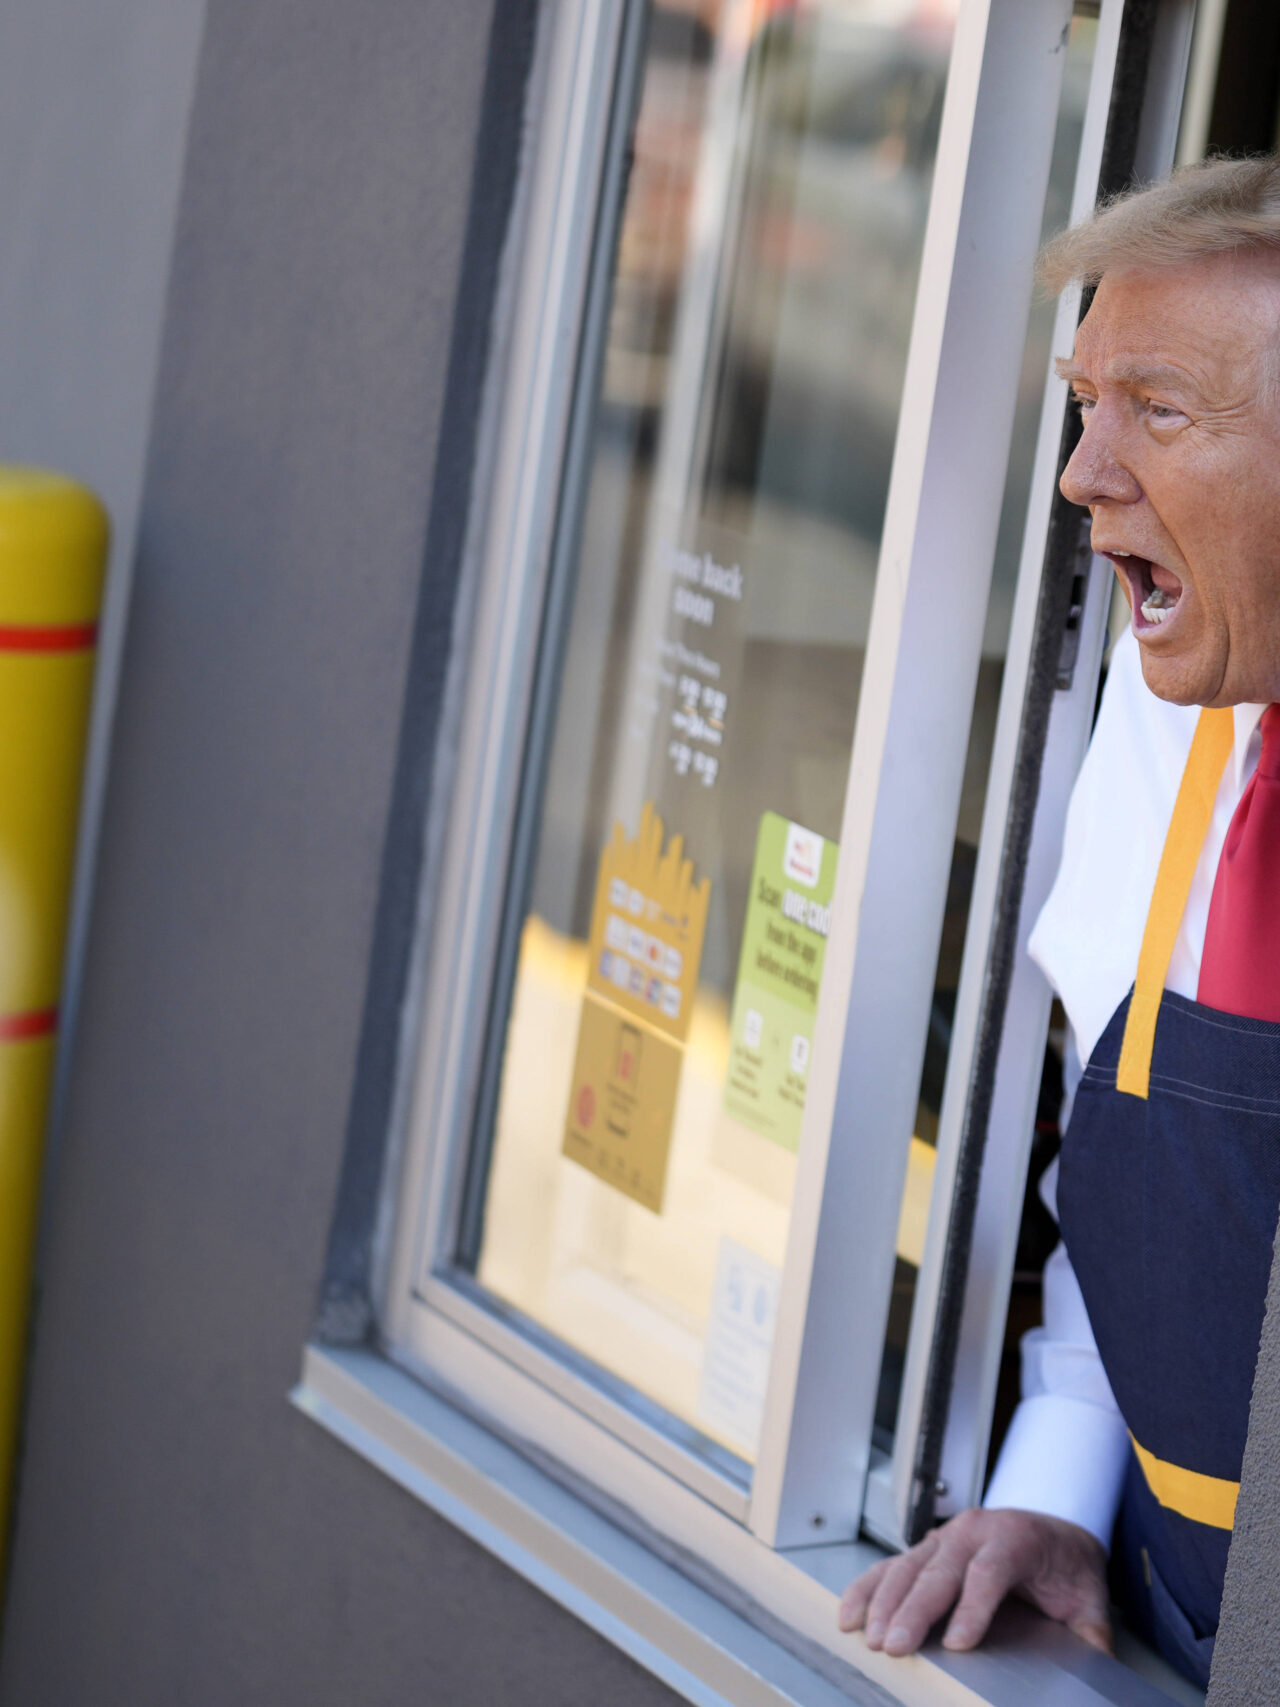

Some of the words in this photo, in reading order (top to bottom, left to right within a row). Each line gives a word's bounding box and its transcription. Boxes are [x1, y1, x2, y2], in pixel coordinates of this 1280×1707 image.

[702, 551, 742, 600] back
[675, 585, 714, 627] soon
[782, 887, 808, 925] one
[806, 899, 832, 938] cod
